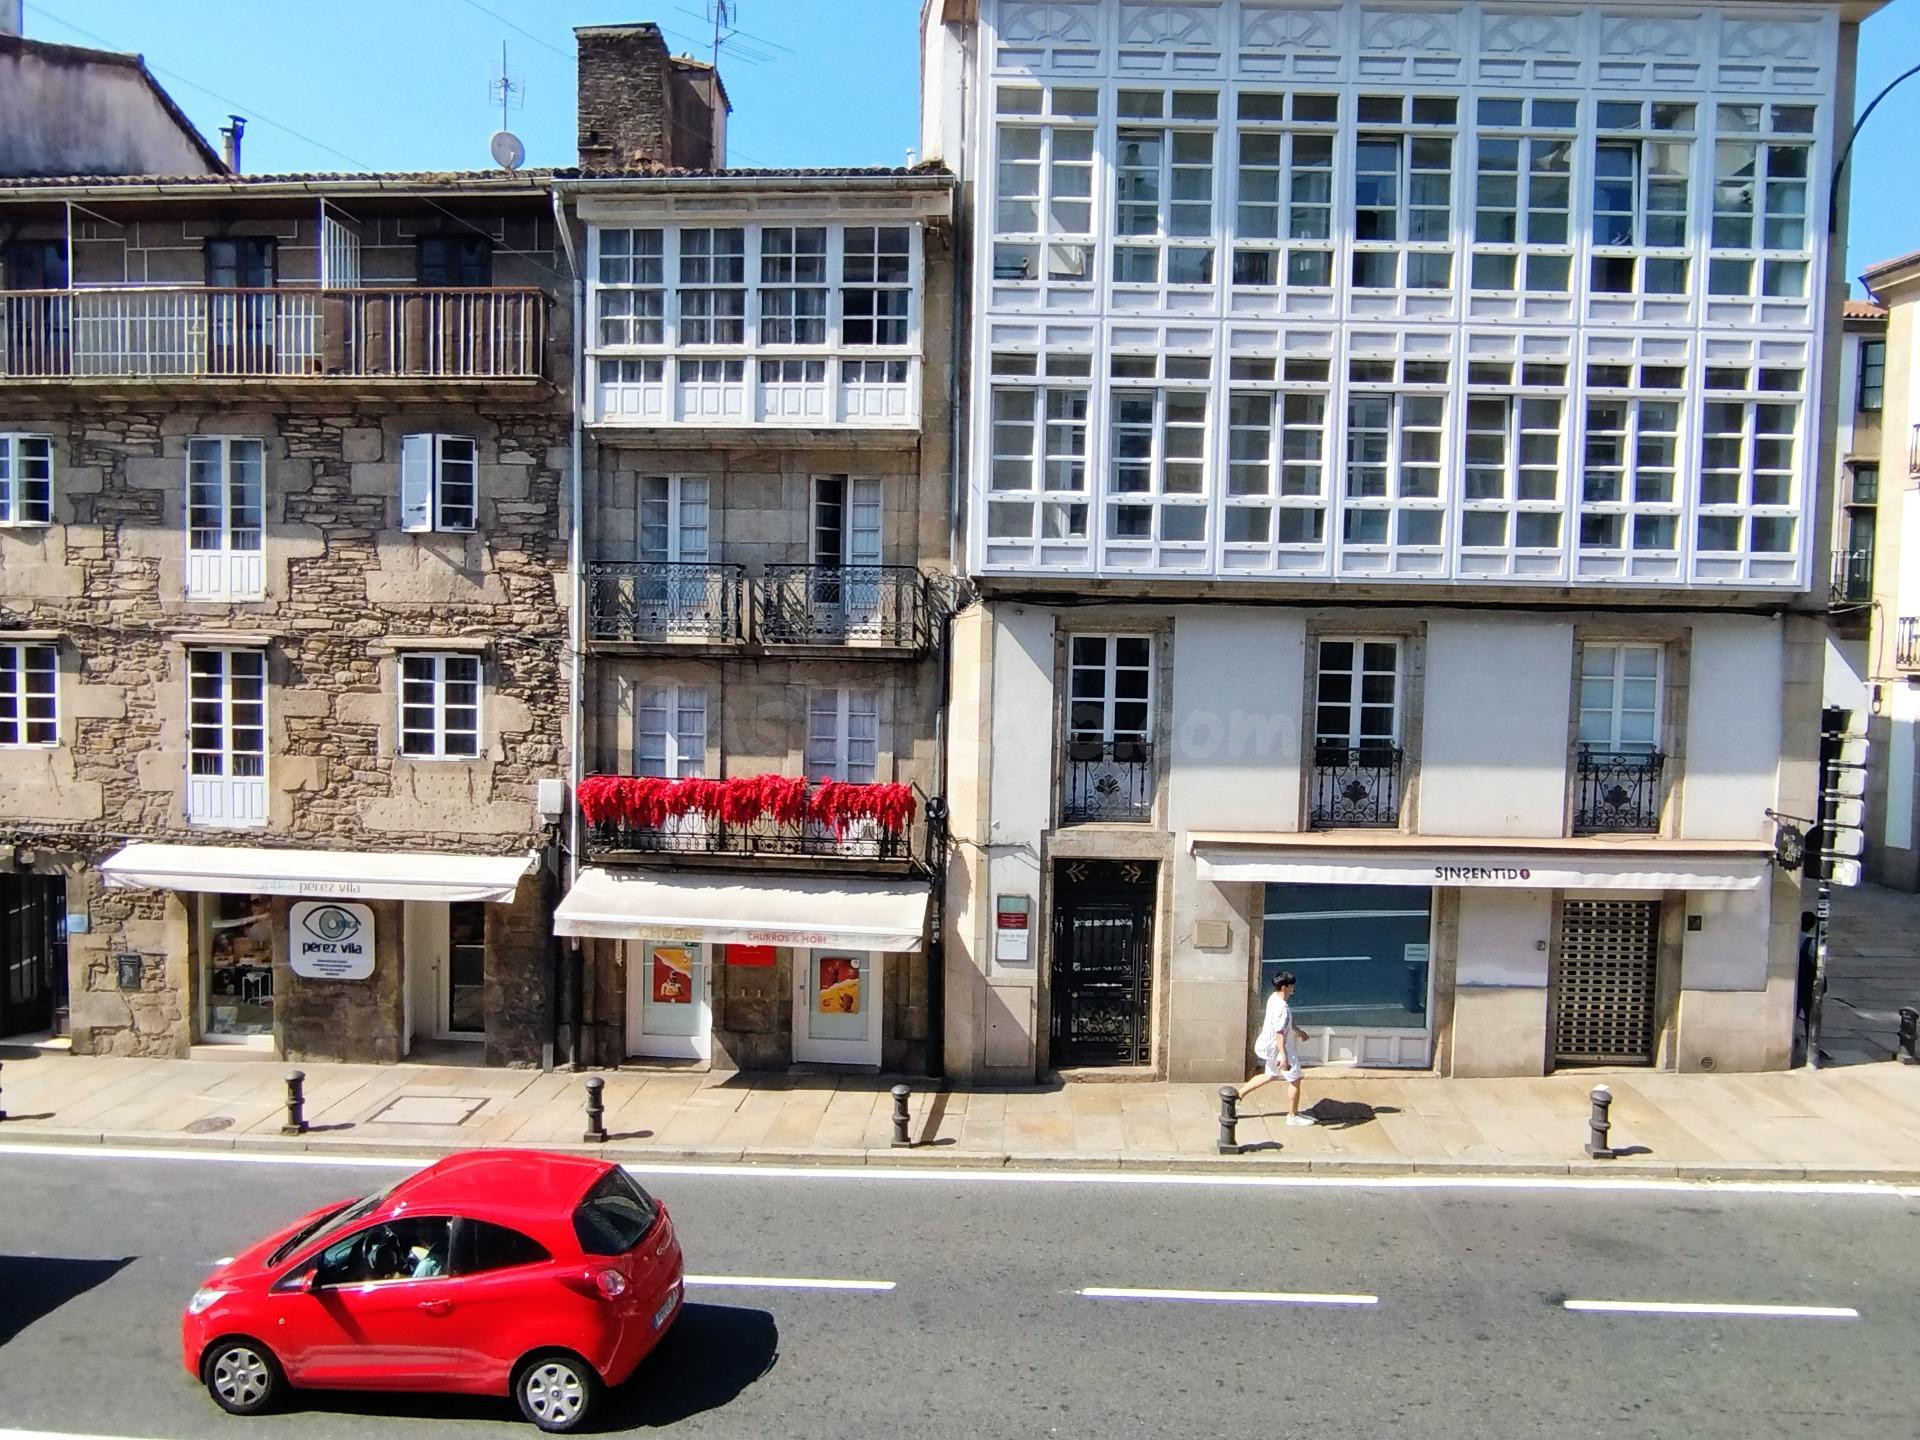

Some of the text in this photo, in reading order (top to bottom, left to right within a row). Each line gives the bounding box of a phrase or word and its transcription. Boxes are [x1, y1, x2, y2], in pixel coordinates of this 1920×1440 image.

[338, 882, 361, 893] vila
[747, 932, 790, 943] CHURROS
[340, 942, 363, 954] vila
